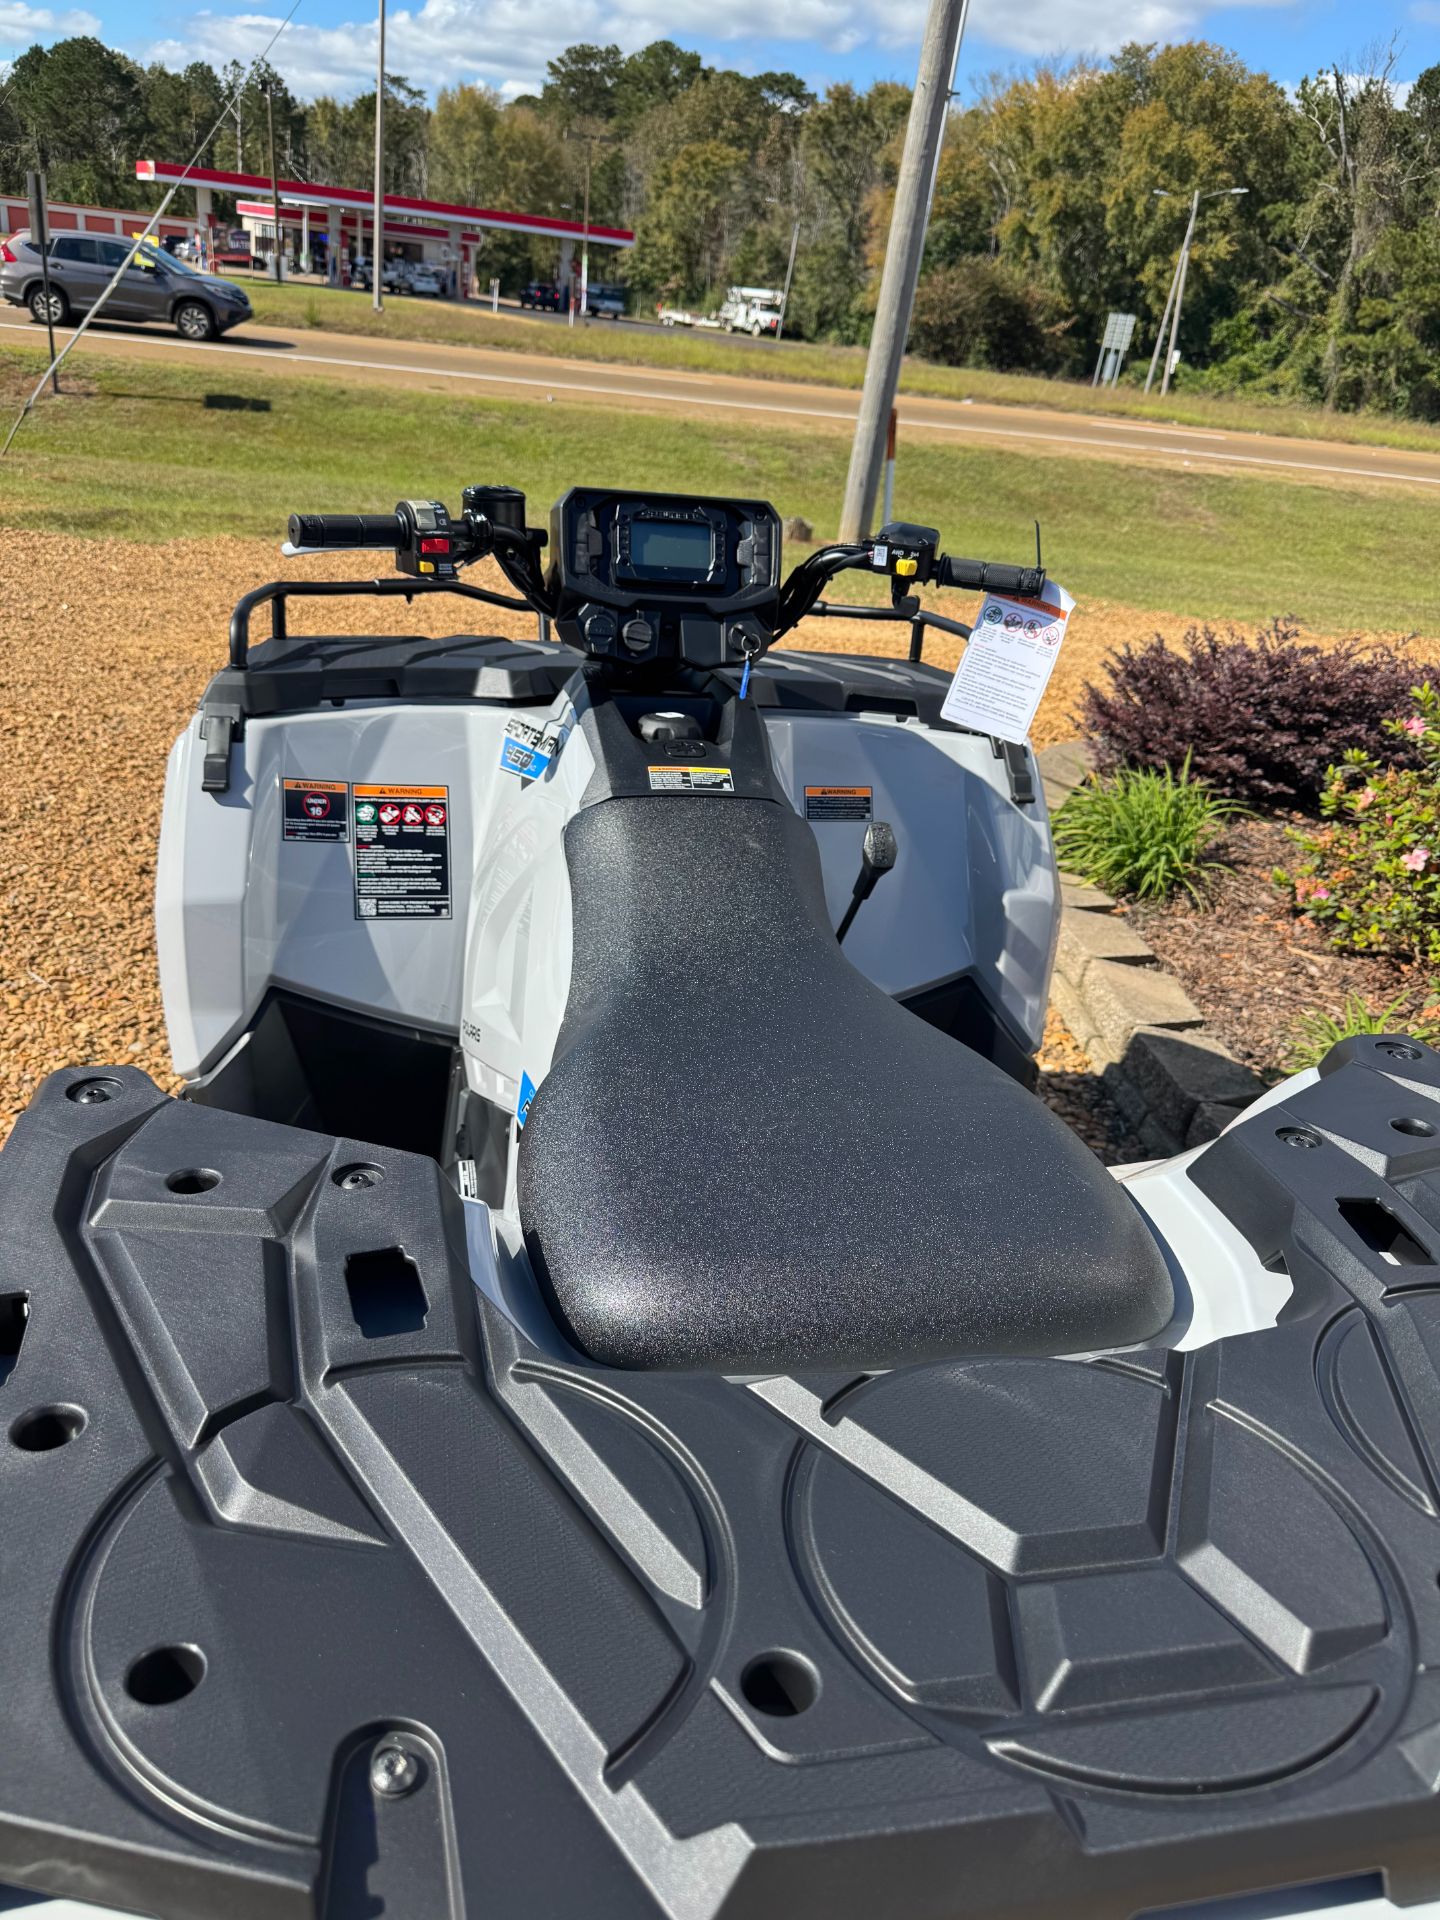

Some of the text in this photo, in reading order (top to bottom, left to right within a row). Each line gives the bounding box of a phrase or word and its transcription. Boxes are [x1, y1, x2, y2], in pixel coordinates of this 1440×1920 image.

[303, 782, 336, 791] WARNING
[827, 788, 857, 796] WARNING
[310, 807, 323, 816] 16
